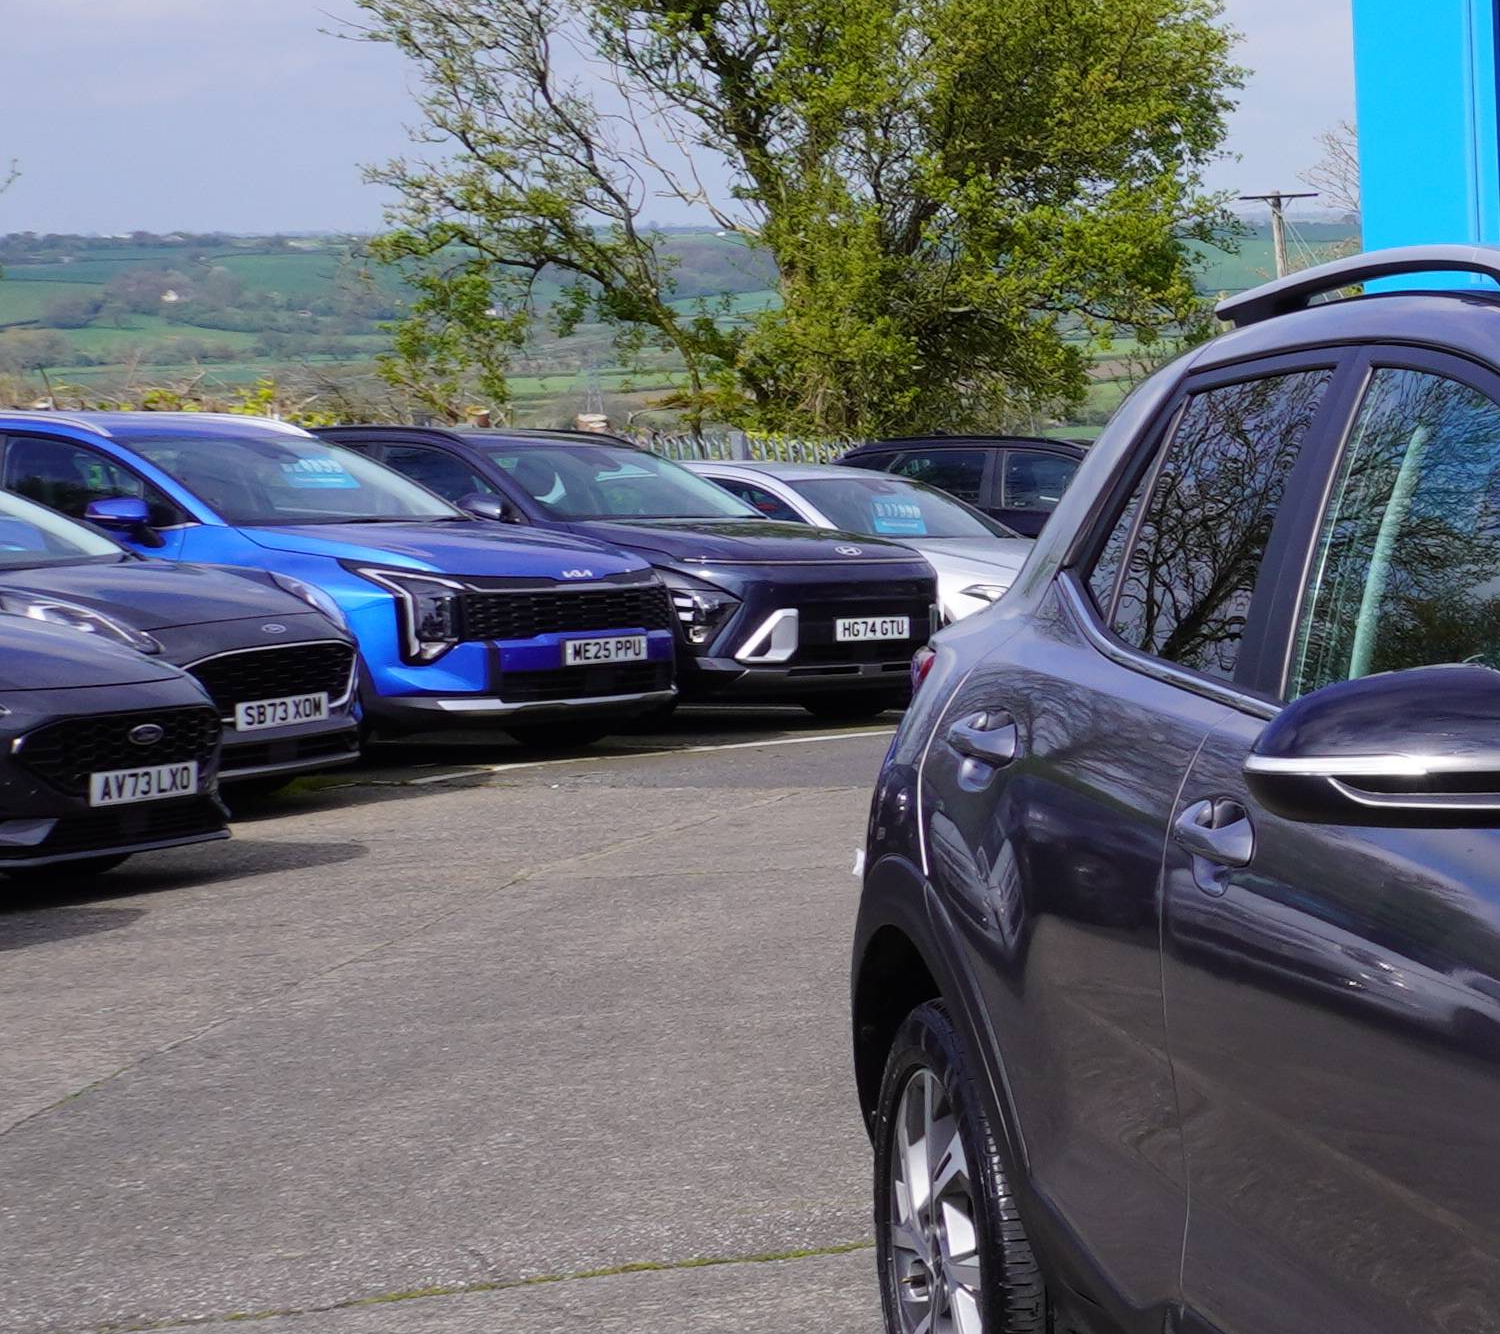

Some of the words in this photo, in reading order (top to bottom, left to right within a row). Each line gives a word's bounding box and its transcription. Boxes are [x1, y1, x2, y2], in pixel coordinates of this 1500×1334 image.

[843, 621, 877, 637] HG74
[880, 620, 904, 636] GTU
[572, 643, 612, 661] ME25
[614, 638, 642, 657] PPU
[245, 701, 288, 726] SB73
[293, 696, 322, 718] XOM
[100, 770, 151, 803] AV73
[156, 767, 191, 794] LXO
